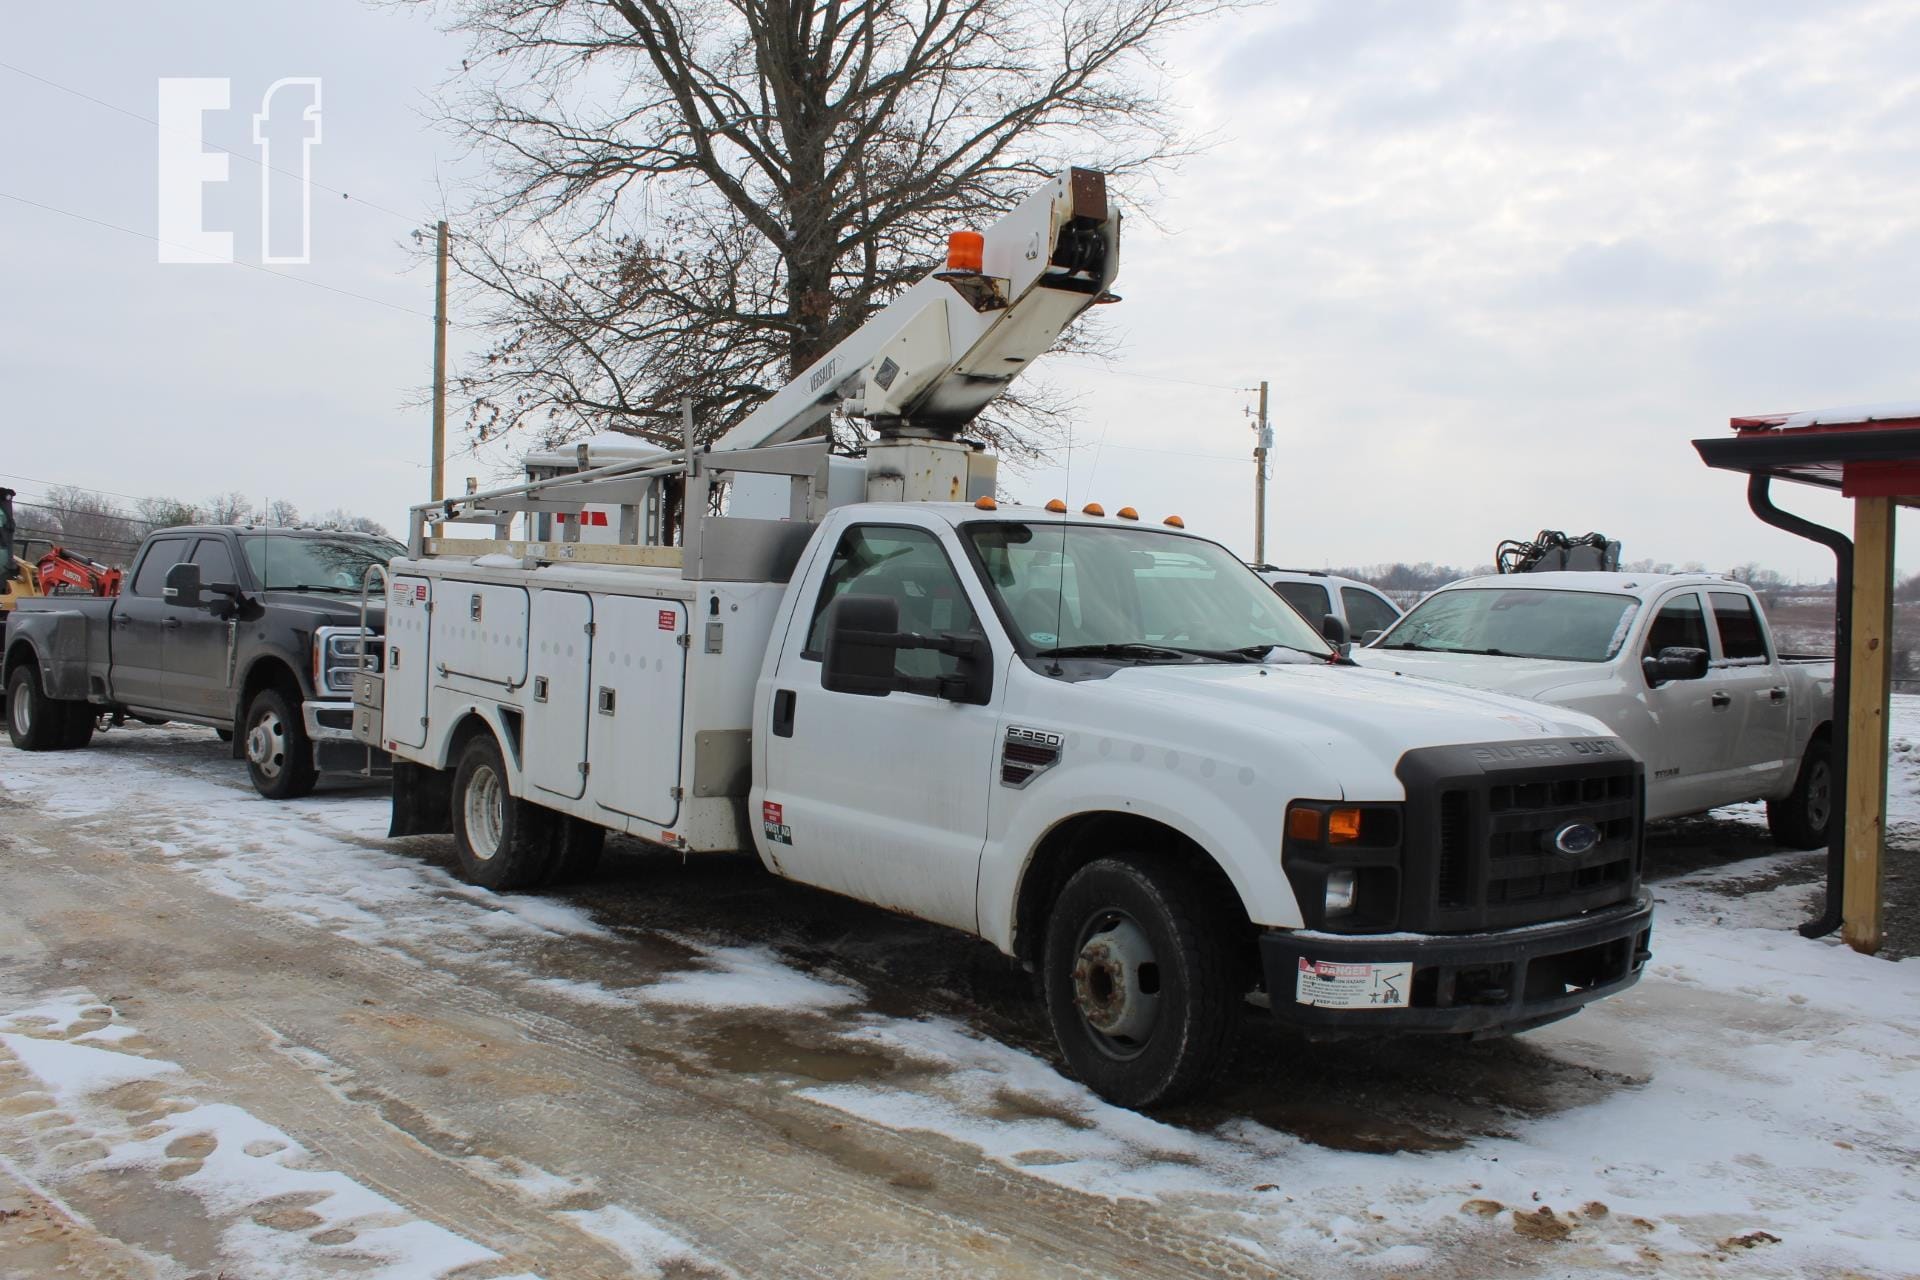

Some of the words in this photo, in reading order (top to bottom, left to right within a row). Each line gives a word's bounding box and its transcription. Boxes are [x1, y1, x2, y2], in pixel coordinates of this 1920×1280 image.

[809, 358, 836, 392] VERSALIFT
[62, 568, 82, 584] KUBOTA
[1007, 727, 1060, 746] F-350
[1472, 743, 1568, 764] SUPER
[1569, 740, 1622, 756] DUTY
